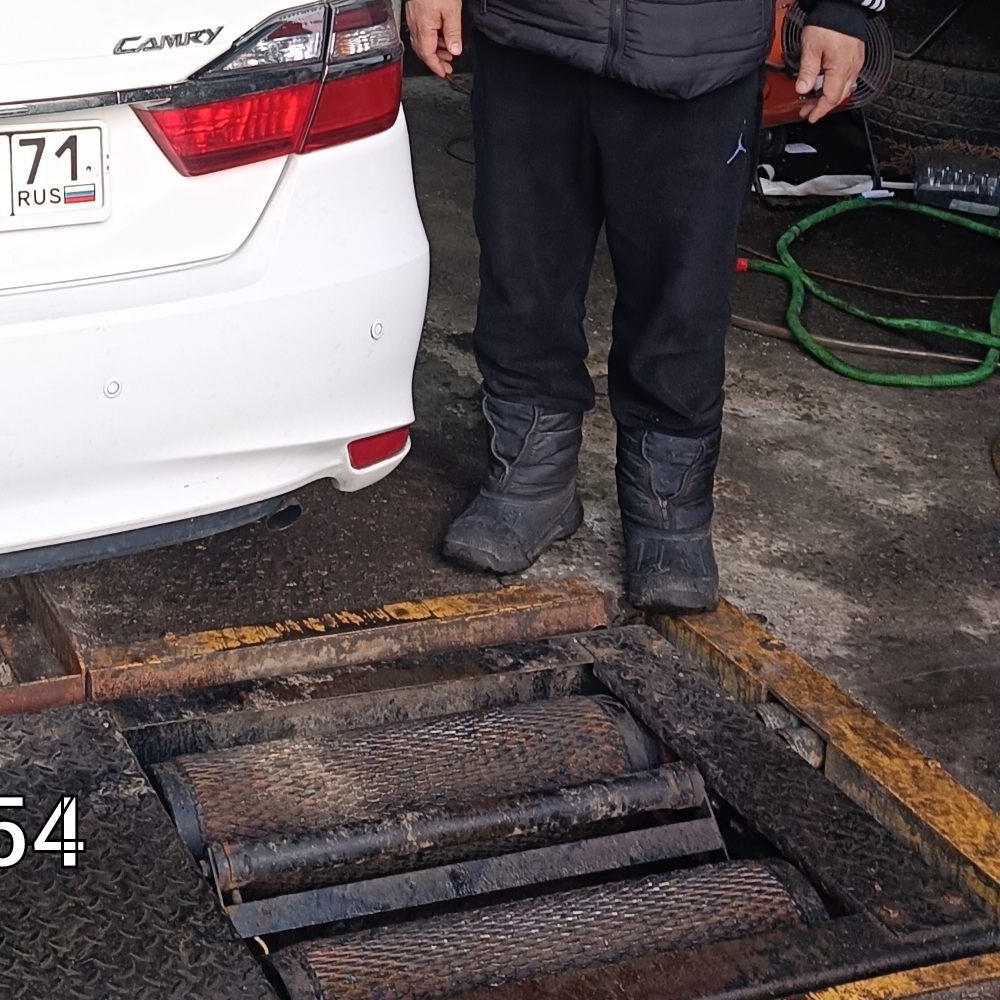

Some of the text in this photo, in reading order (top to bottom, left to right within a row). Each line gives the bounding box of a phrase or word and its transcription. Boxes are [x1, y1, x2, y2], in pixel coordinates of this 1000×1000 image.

[113, 25, 225, 55] CAMRY
[18, 134, 79, 185] 71
[17, 187, 62, 207] RUS
